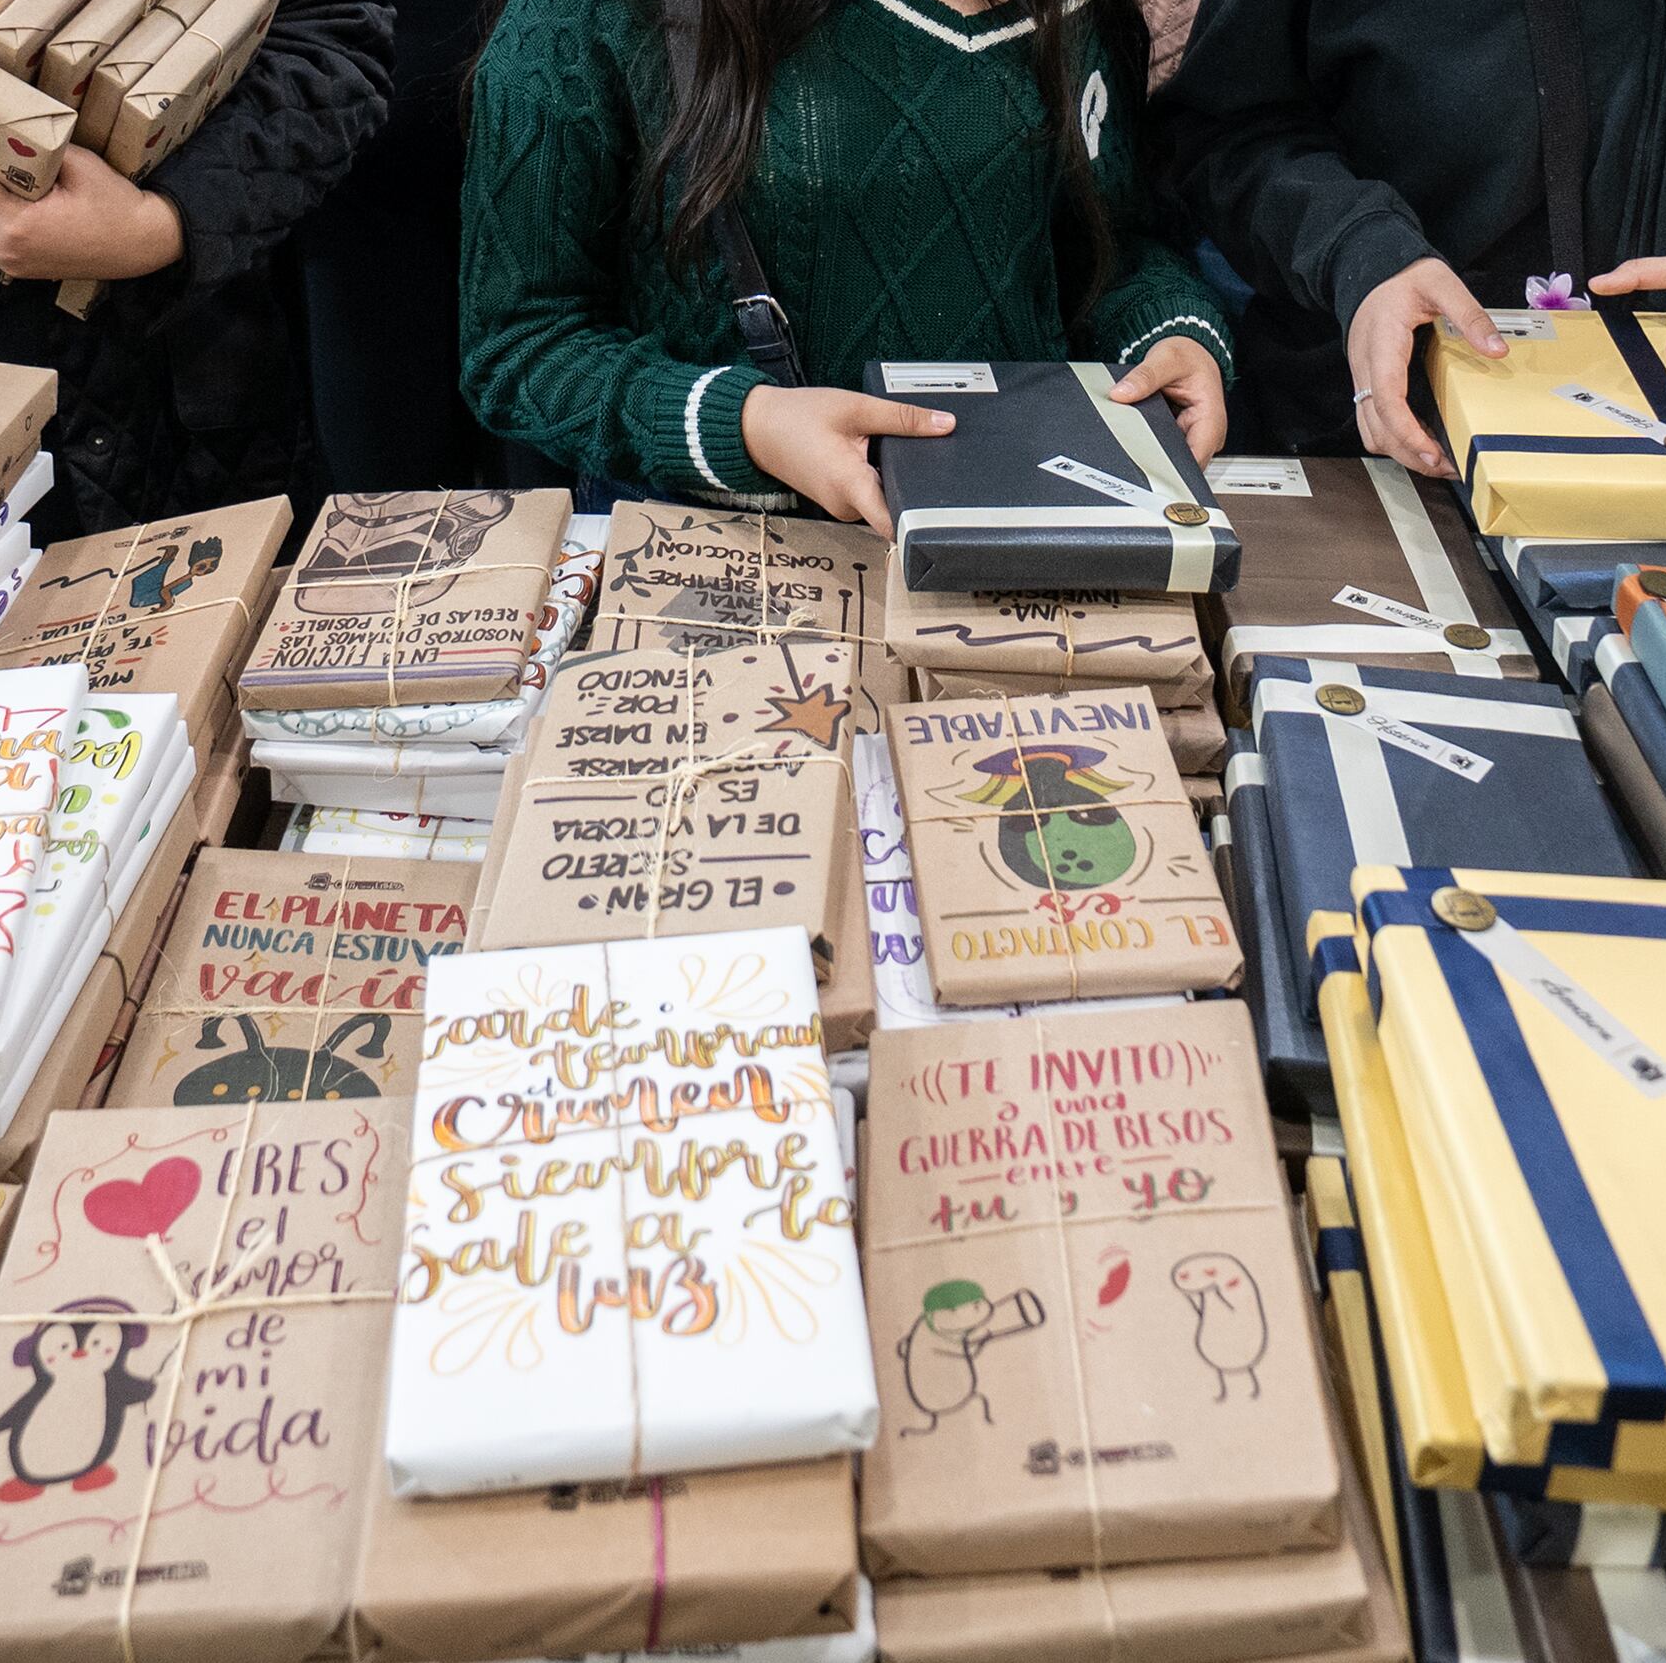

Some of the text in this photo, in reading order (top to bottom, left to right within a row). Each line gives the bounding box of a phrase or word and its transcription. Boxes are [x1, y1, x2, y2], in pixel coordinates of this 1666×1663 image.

[646, 569, 758, 594] SIEMPRE
[724, 562, 761, 579] EN
[412, 607, 519, 627] REGLAS DE
[1014, 603, 1070, 623] UNA
[279, 633, 314, 650] LAS
[424, 628, 525, 645] NOSOTROS
[411, 646, 440, 665] EN
[576, 667, 715, 694] VENCIDO
[617, 695, 680, 717] POR
[554, 723, 708, 749] EN DARSE
[903, 700, 1153, 747] INEVITABLE
[718, 779, 760, 804] ES
[705, 813, 802, 839] DE LA
[606, 876, 764, 914] EL GRAN
[1034, 891, 1136, 926] es
[212, 891, 468, 934] EL PLANETA
[202, 922, 315, 957] NUNCA
[950, 914, 1231, 964] EL CONTACTO
[1053, 1090, 1130, 1116] una
[898, 1109, 1235, 1177] GUERRA DE BESOS
[214, 1138, 354, 1200] ERES
[1006, 1153, 1117, 1187] entre
[235, 1205, 290, 1253] el
[225, 1311, 287, 1353] de
[195, 1349, 273, 1396] mi
[143, 1396, 332, 1473] vida
